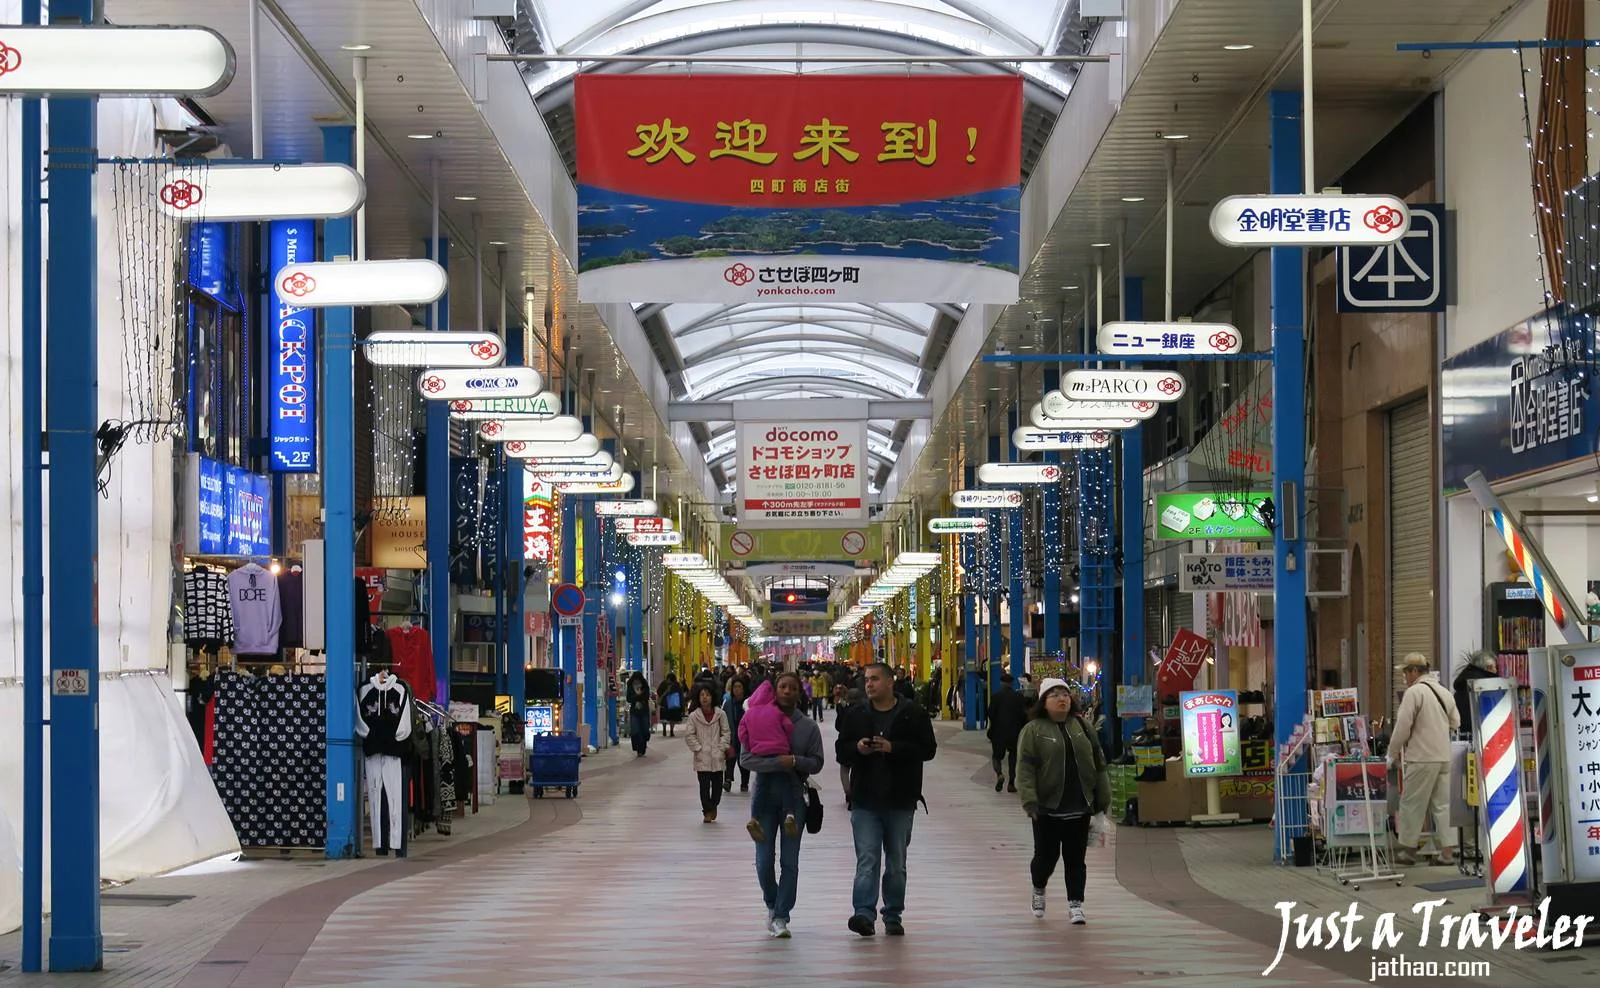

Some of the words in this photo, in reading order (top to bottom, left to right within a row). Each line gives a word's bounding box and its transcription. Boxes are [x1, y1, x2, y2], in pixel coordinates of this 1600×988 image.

[750, 179, 850, 194] 四町商店街
[1237, 208, 1351, 232] 金明堂書店
[757, 286, 836, 297] yonkacho.com
[1112, 333, 1195, 350] ニュー銀座
[279, 298, 306, 424] ACKPOT
[482, 397, 549, 413] TERUYA
[766, 427, 838, 442] docomo
[292, 452, 310, 463] 2F
[752, 444, 853, 461] ドコモショップ
[749, 464, 855, 480] させぼ四ヶ町店
[239, 588, 266, 601] DOPE
[1572, 686, 1600, 718] 大
[1578, 723, 1600, 735] シャン
[1579, 740, 1600, 751] シャン
